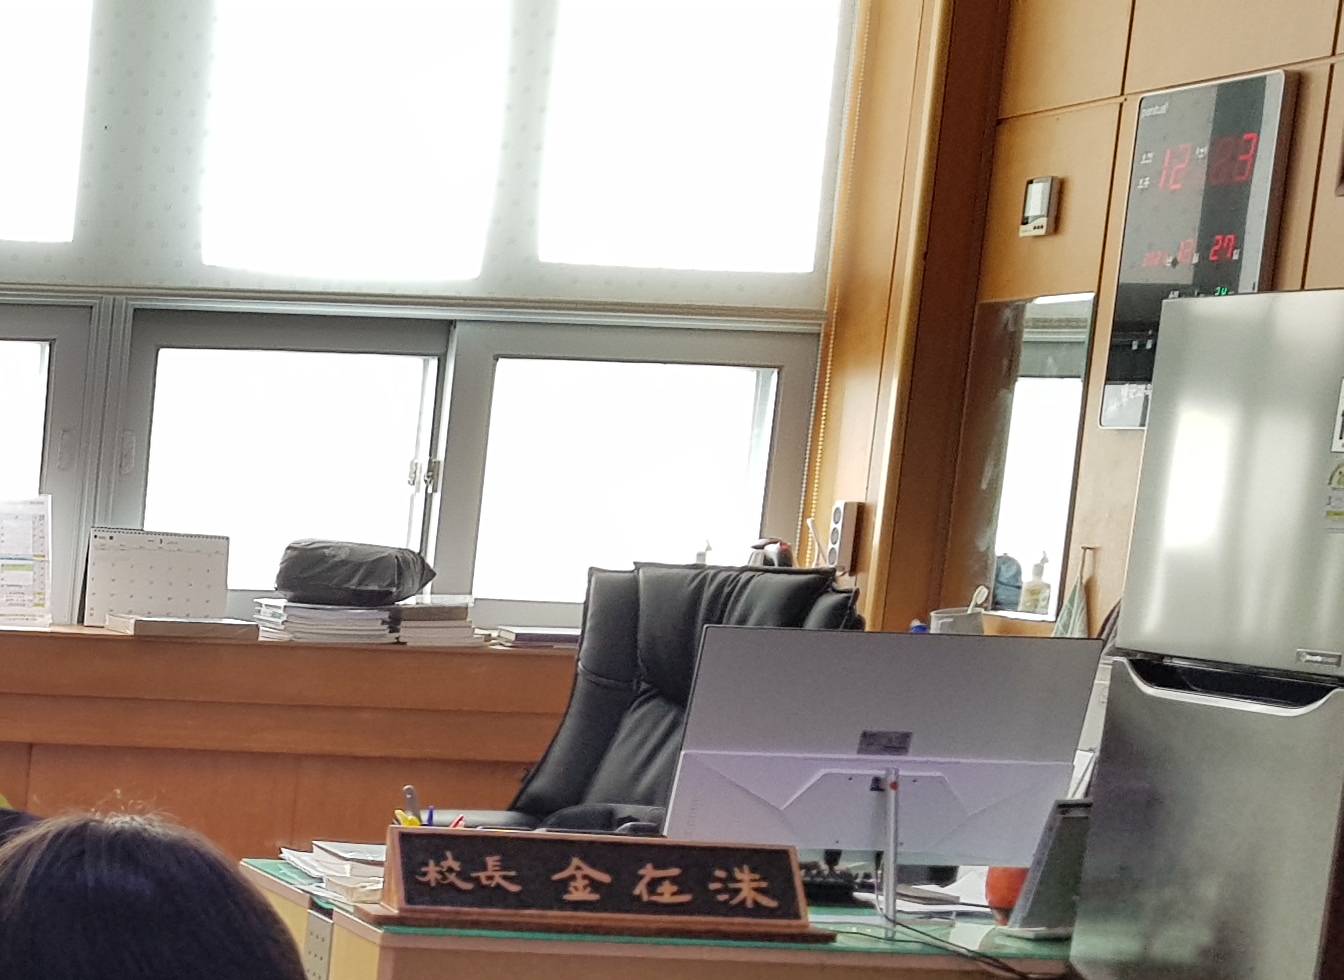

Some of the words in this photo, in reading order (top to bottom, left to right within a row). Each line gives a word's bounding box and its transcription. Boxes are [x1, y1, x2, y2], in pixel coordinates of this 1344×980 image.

[1159, 142, 1193, 191] 12
[1234, 132, 1261, 183] 3
[1208, 234, 1238, 261] 27
[415, 850, 523, 893] 校長
[550, 855, 779, 909] 金在洙
